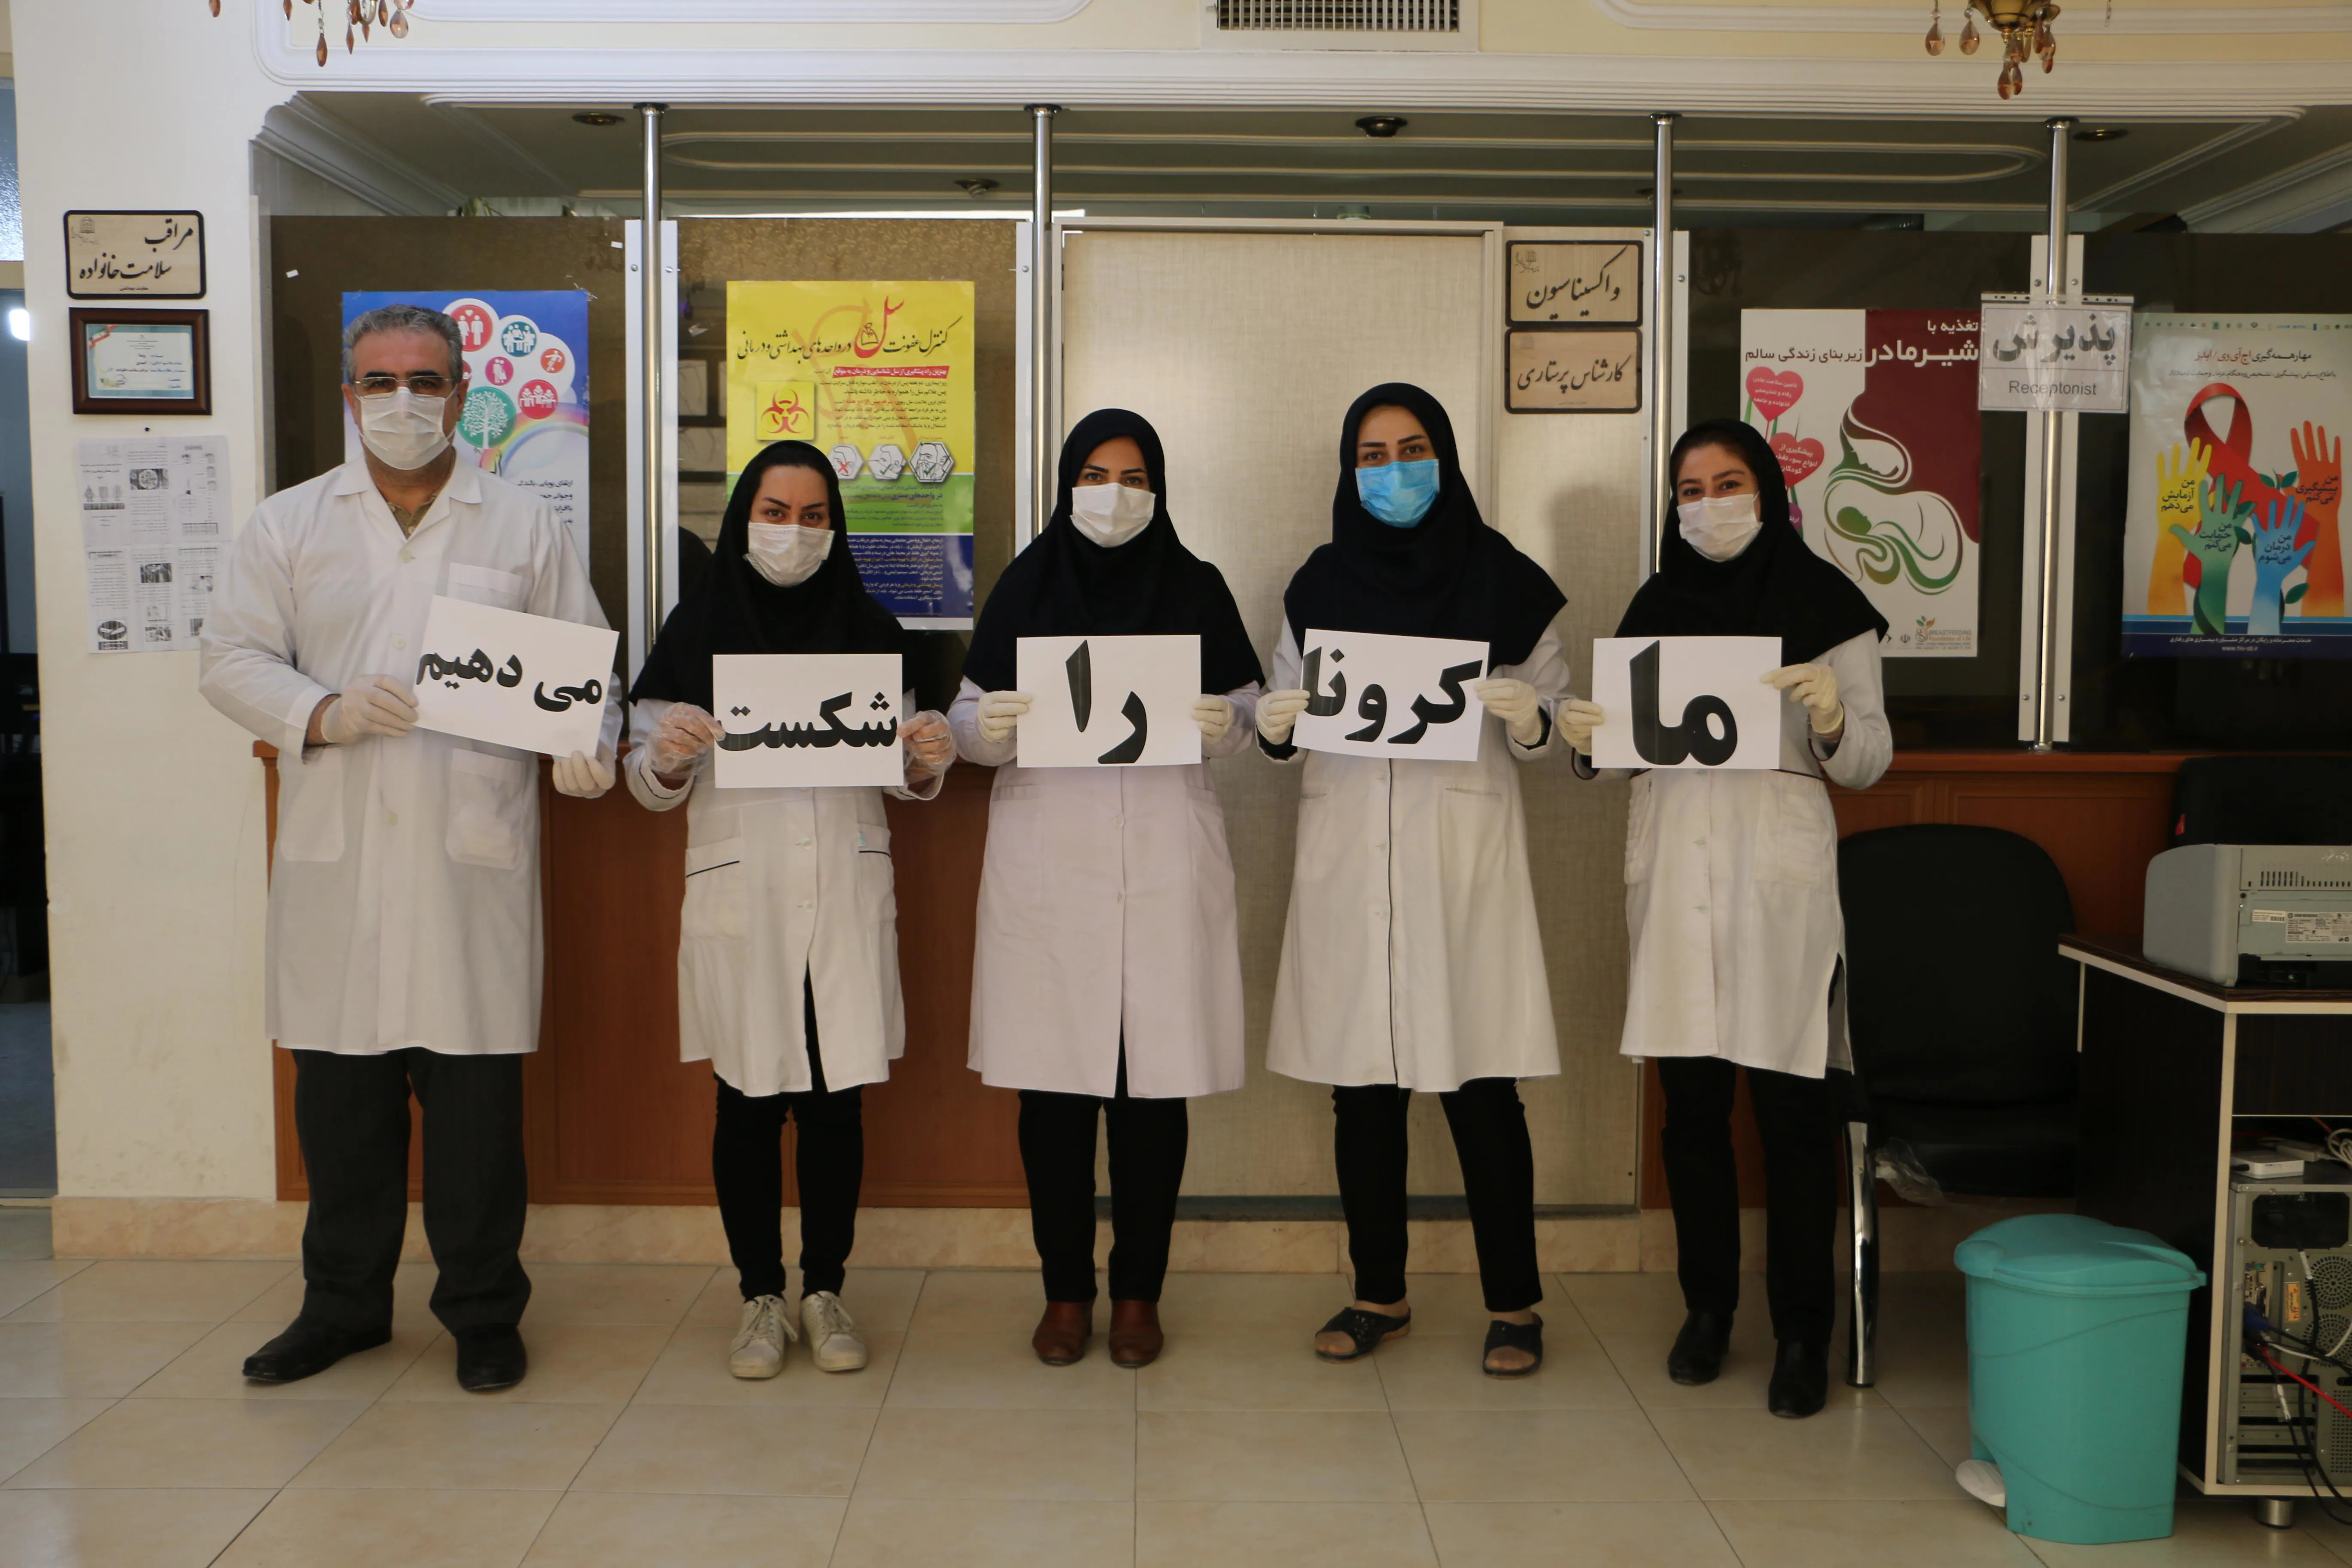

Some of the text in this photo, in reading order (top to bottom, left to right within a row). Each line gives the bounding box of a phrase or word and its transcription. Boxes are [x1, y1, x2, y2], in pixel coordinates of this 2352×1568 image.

[144, 217, 194, 253] مراقب
[79, 251, 172, 279] سلامت خانواده
[1526, 245, 1628, 320] واکسیناسیون
[853, 295, 905, 359] سل
[918, 315, 963, 358] کنترل
[1927, 319, 1979, 332] تغذیه با
[737, 330, 765, 360] درمانی
[769, 329, 802, 364] بهداشتی
[802, 337, 841, 360] واحدهای
[882, 334, 920, 354] عفونت
[1992, 313, 2116, 366] پذیرش
[1745, 346, 1862, 363] زیر بنای زندگی سالم
[1864, 339, 1979, 368] شیر مادر
[2193, 349, 2211, 361] ایدز
[2294, 350, 2312, 362] مهار
[1517, 354, 1632, 394] کارشناس پرستاری
[2009, 380, 2097, 396] Receptonist
[1785, 447, 1813, 459] پیشگیری
[2181, 479, 2195, 488] من
[2295, 481, 2338, 495] پیشگیری
[2324, 475, 2339, 485] من
[2162, 487, 2194, 502] آزمایش
[2199, 529, 2231, 542] حمایت
[2218, 523, 2233, 533] من
[2277, 535, 2292, 544] من
[2263, 541, 2291, 554] درمان
[416, 648, 602, 712] می دهیم
[1065, 639, 1148, 765] را
[1302, 646, 1483, 745] کرونا
[1629, 640, 1738, 767] ما
[715, 691, 898, 752] شکست
